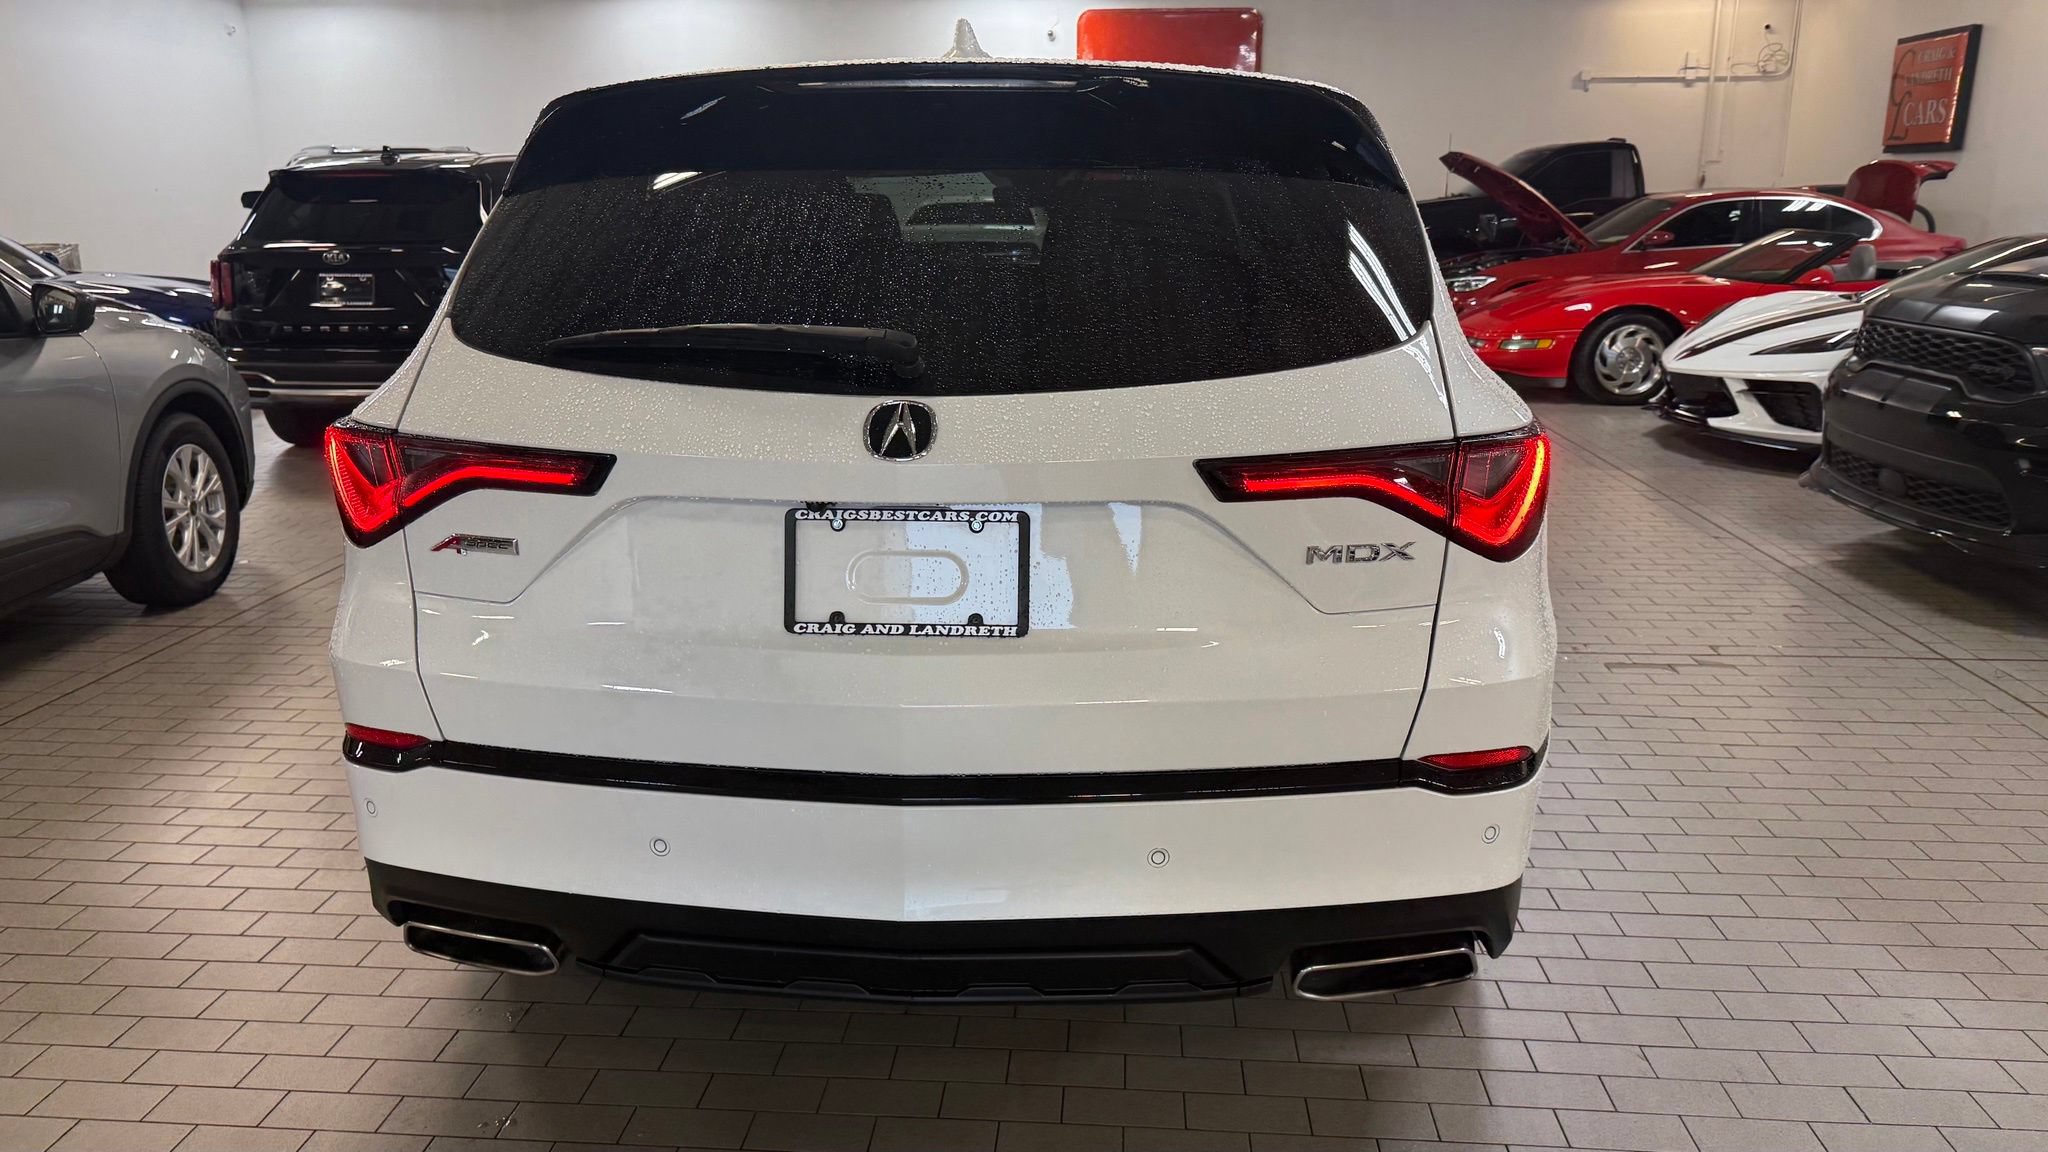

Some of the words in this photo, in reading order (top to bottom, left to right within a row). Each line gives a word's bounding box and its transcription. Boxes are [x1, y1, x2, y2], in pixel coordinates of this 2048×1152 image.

[1904, 98, 1949, 127] CARS
[326, 252, 345, 264] KIA
[794, 509, 1019, 523] CRAIGSBESTCARS.COM
[1305, 541, 1416, 565] MDX
[793, 623, 857, 635] CRAIG
[861, 624, 905, 636] AND
[909, 625, 1018, 637] LANDRETH
